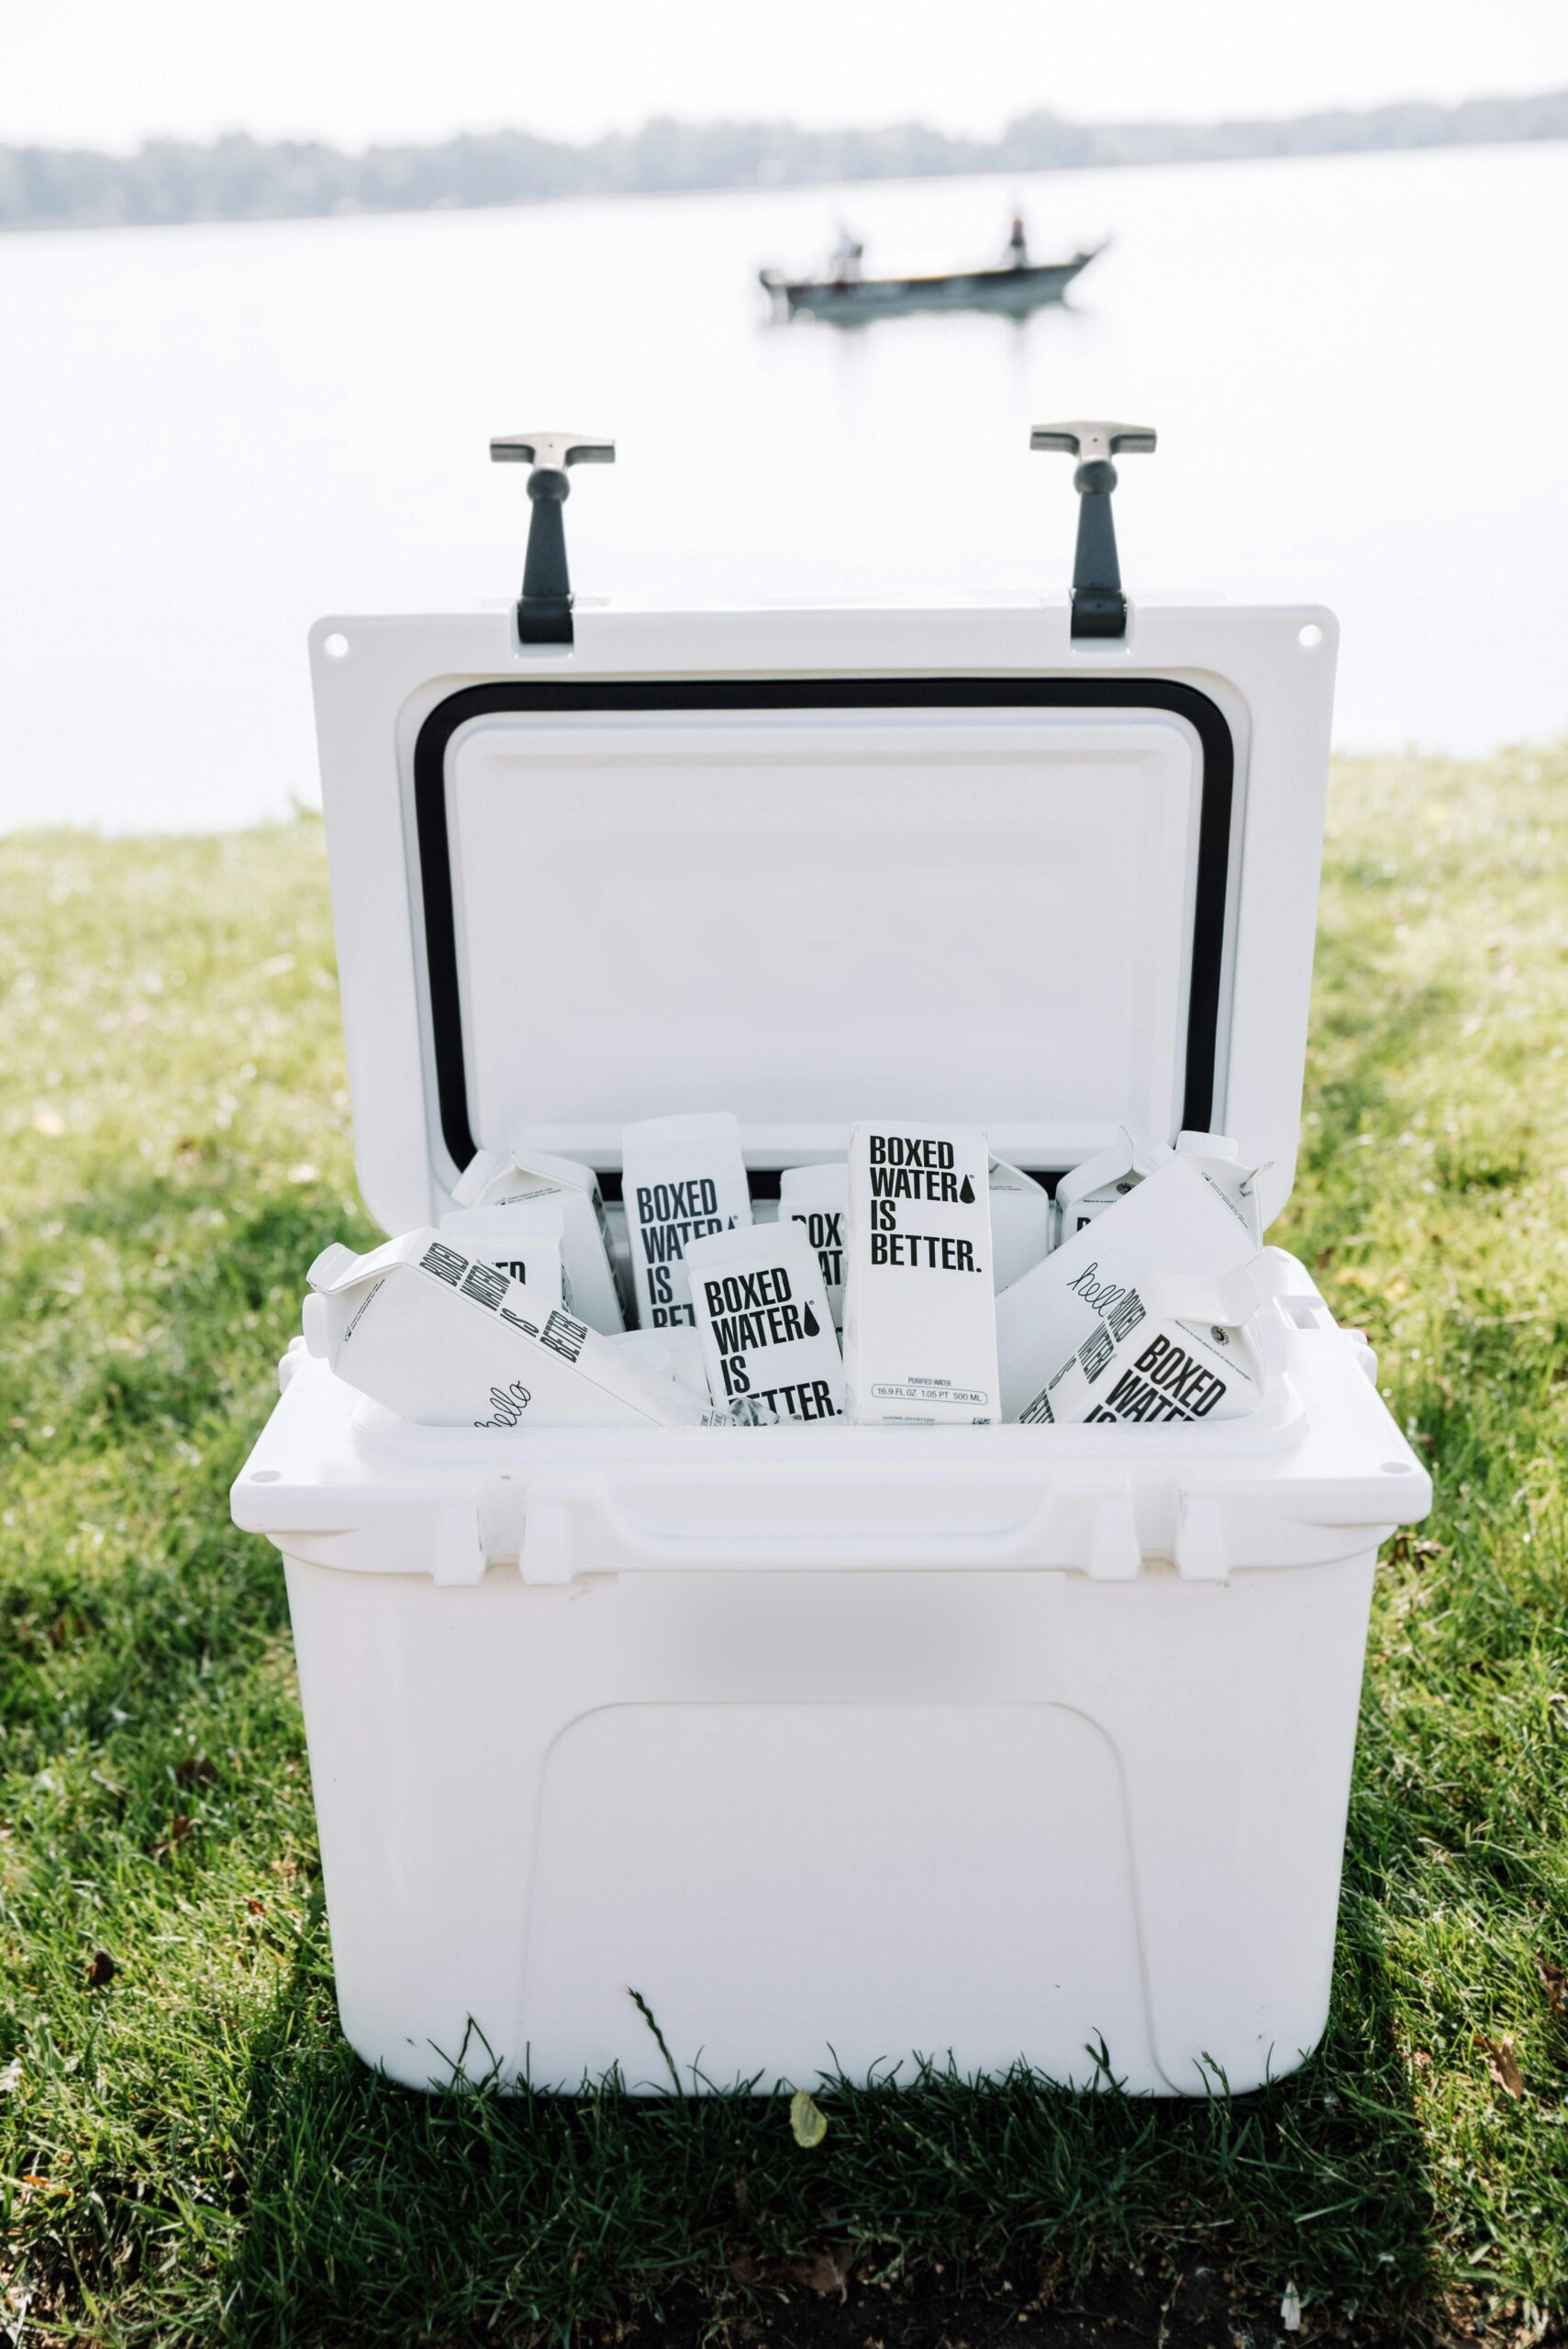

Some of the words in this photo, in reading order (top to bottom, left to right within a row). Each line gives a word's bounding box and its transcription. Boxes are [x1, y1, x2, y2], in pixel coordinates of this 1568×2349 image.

[870, 1135, 954, 1170] BOXED
[637, 1178, 717, 1224] BOXED
[870, 1167, 958, 1203] WATER
[871, 1199, 896, 1231] IS
[419, 1242, 469, 1287] BOXED
[872, 1233, 982, 1273] BETTER.
[460, 1264, 510, 1311] WATER
[647, 1265, 673, 1305] IS
[704, 1267, 792, 1317] BOXED
[1066, 1263, 1126, 1318] hell
[500, 1308, 539, 1338] IS
[711, 1304, 805, 1355] WATER
[1107, 1288, 1147, 1343] BOXED
[1077, 1320, 1115, 1380] WATER
[720, 1355, 751, 1396] IS
[908, 1376, 933, 1386] PURIFIED
[934, 1378, 951, 1386] WATER
[1048, 1354, 1076, 1390] IS
[1134, 1333, 1227, 1417] BOXED
[728, 1380, 843, 1421] TTER.
[921, 1390, 937, 1398] 1.05
[939, 1391, 949, 1399] PT
[953, 1392, 968, 1400] 500
[970, 1394, 982, 1402] ML
